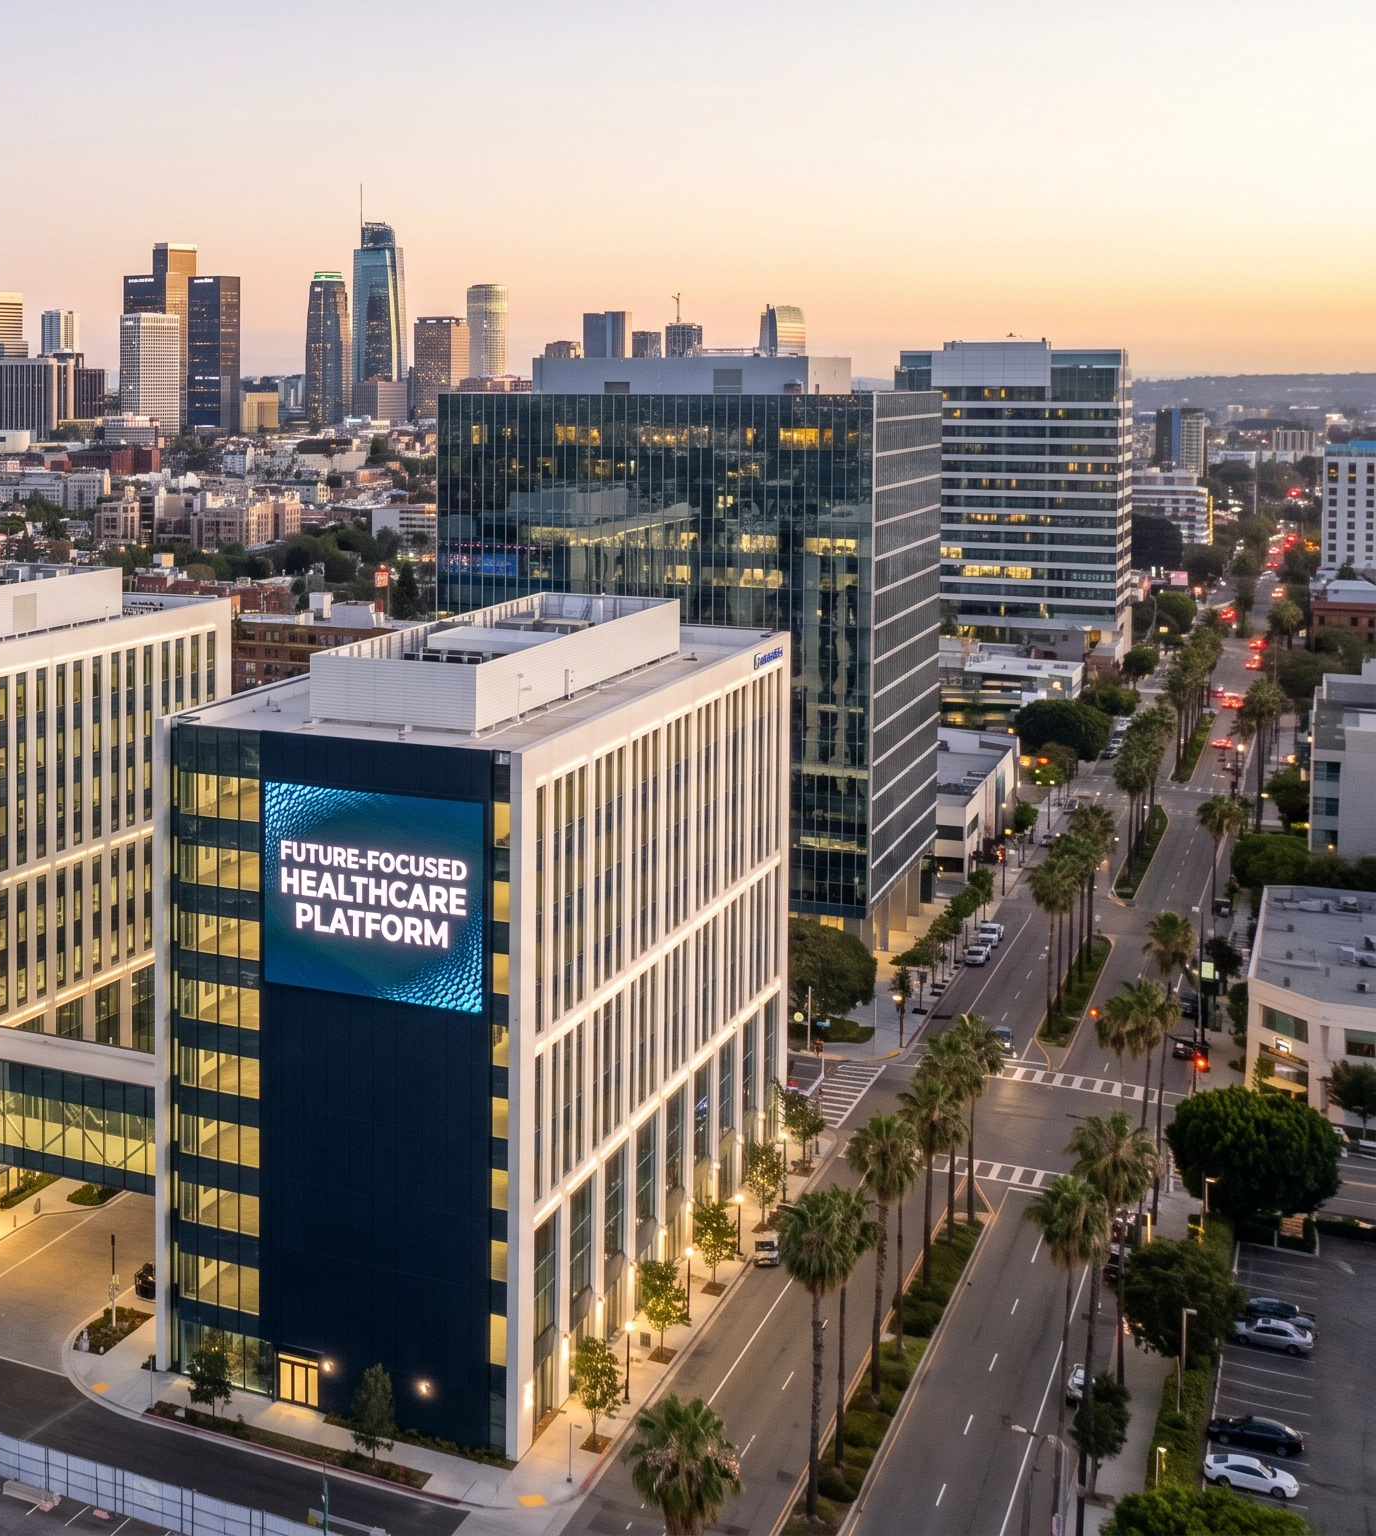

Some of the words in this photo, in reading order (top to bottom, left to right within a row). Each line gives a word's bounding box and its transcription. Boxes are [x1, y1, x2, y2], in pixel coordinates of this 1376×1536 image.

[280, 839, 468, 881] FUTURE-FOCUSED
[280, 866, 468, 916] HEALTHCARE
[295, 901, 449, 949] PLATFORM
